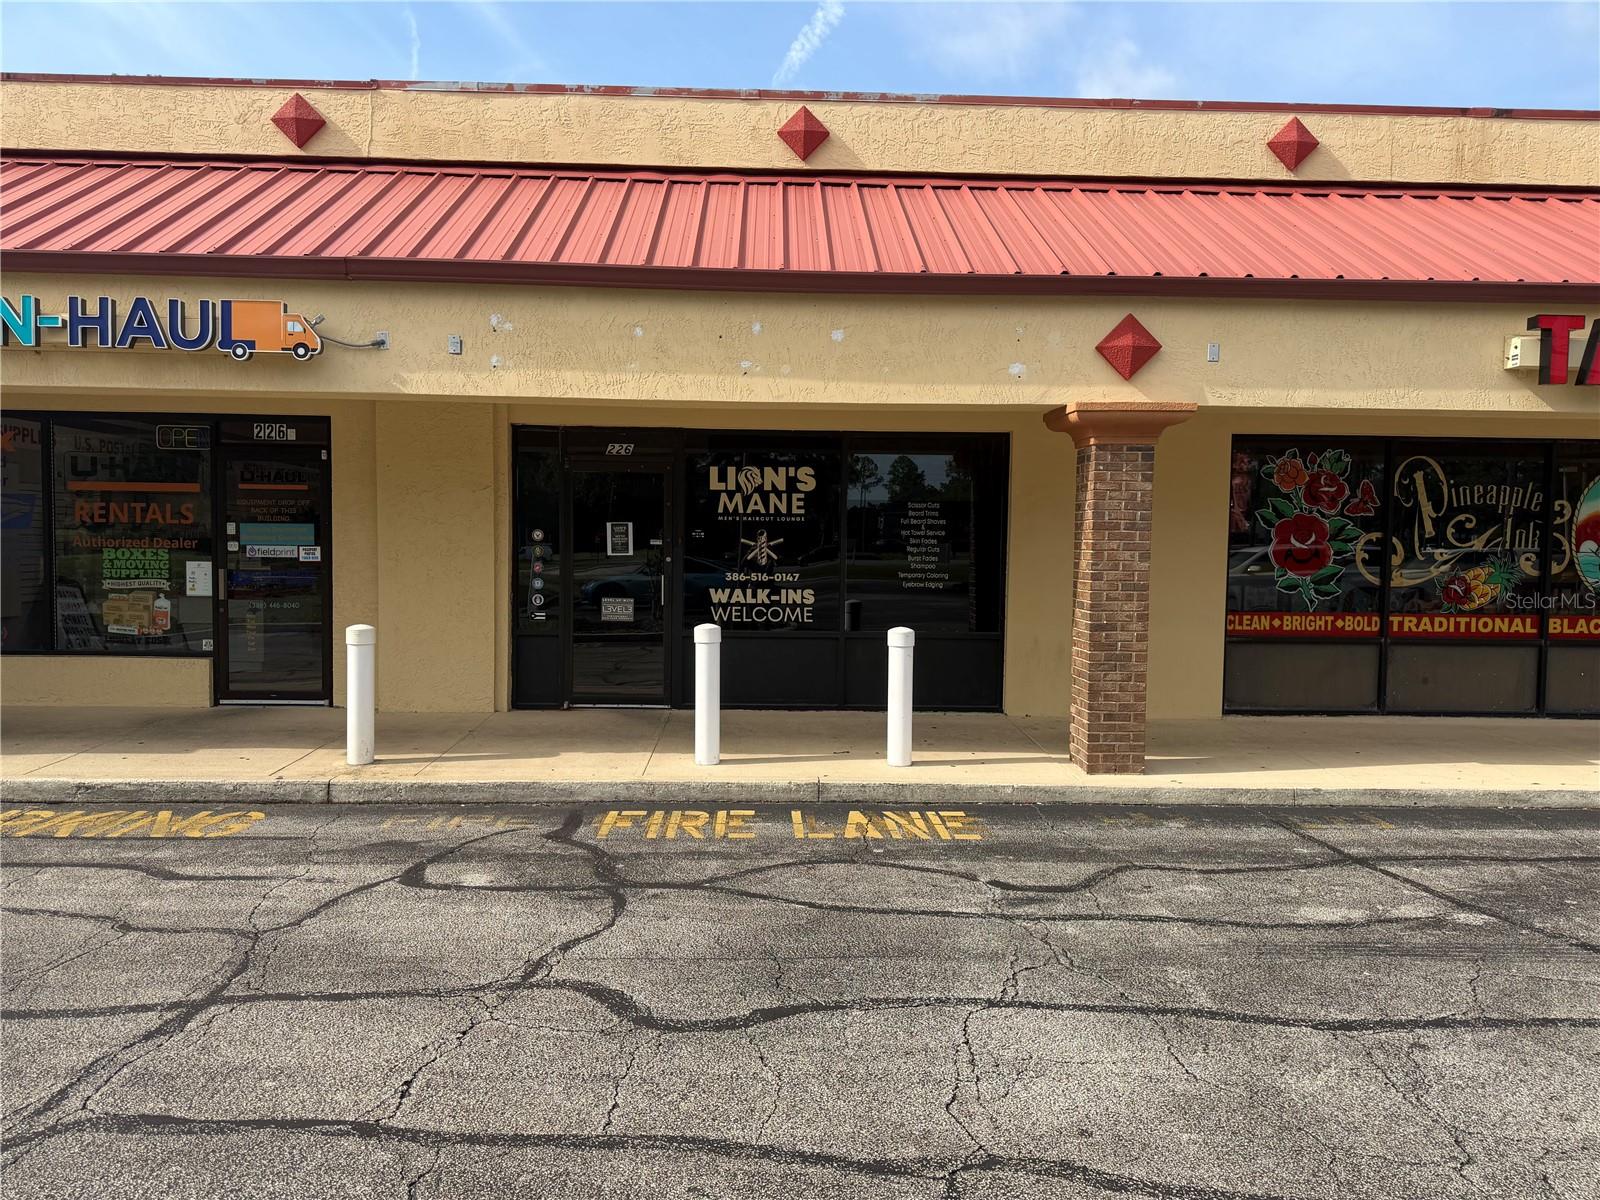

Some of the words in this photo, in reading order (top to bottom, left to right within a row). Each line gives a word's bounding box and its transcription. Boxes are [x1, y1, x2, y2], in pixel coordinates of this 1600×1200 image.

[158, 427, 209, 448] OPE
[254, 424, 286, 440] 226
[606, 444, 633, 455] 226
[709, 465, 817, 493] LION'S
[717, 492, 806, 514] MANE
[1394, 455, 1544, 545] Pineapple
[74, 500, 195, 526] RENTALS
[1504, 512, 1543, 550] Ink
[72, 535, 149, 549] Authorized
[152, 536, 199, 550] Dealer
[101, 549, 170, 560] BOXES
[257, 546, 295, 557] fieldprint
[102, 560, 111, 569] &
[112, 560, 169, 569] MOVING
[101, 569, 170, 579] SUPPLIES
[725, 572, 801, 582] 386-516-0147
[110, 580, 137, 588] HIGHEST
[137, 580, 163, 588] QUALITY
[709, 587, 816, 605] WALK-INS
[710, 606, 815, 623] WELCOME
[1227, 615, 1270, 631] CLEAN
[1283, 615, 1334, 631] BRIGHT
[1345, 615, 1381, 631] BOLD
[1390, 616, 1538, 633] TRADITIONAL
[596, 810, 758, 839] FIRE
[790, 810, 983, 841] LANE
